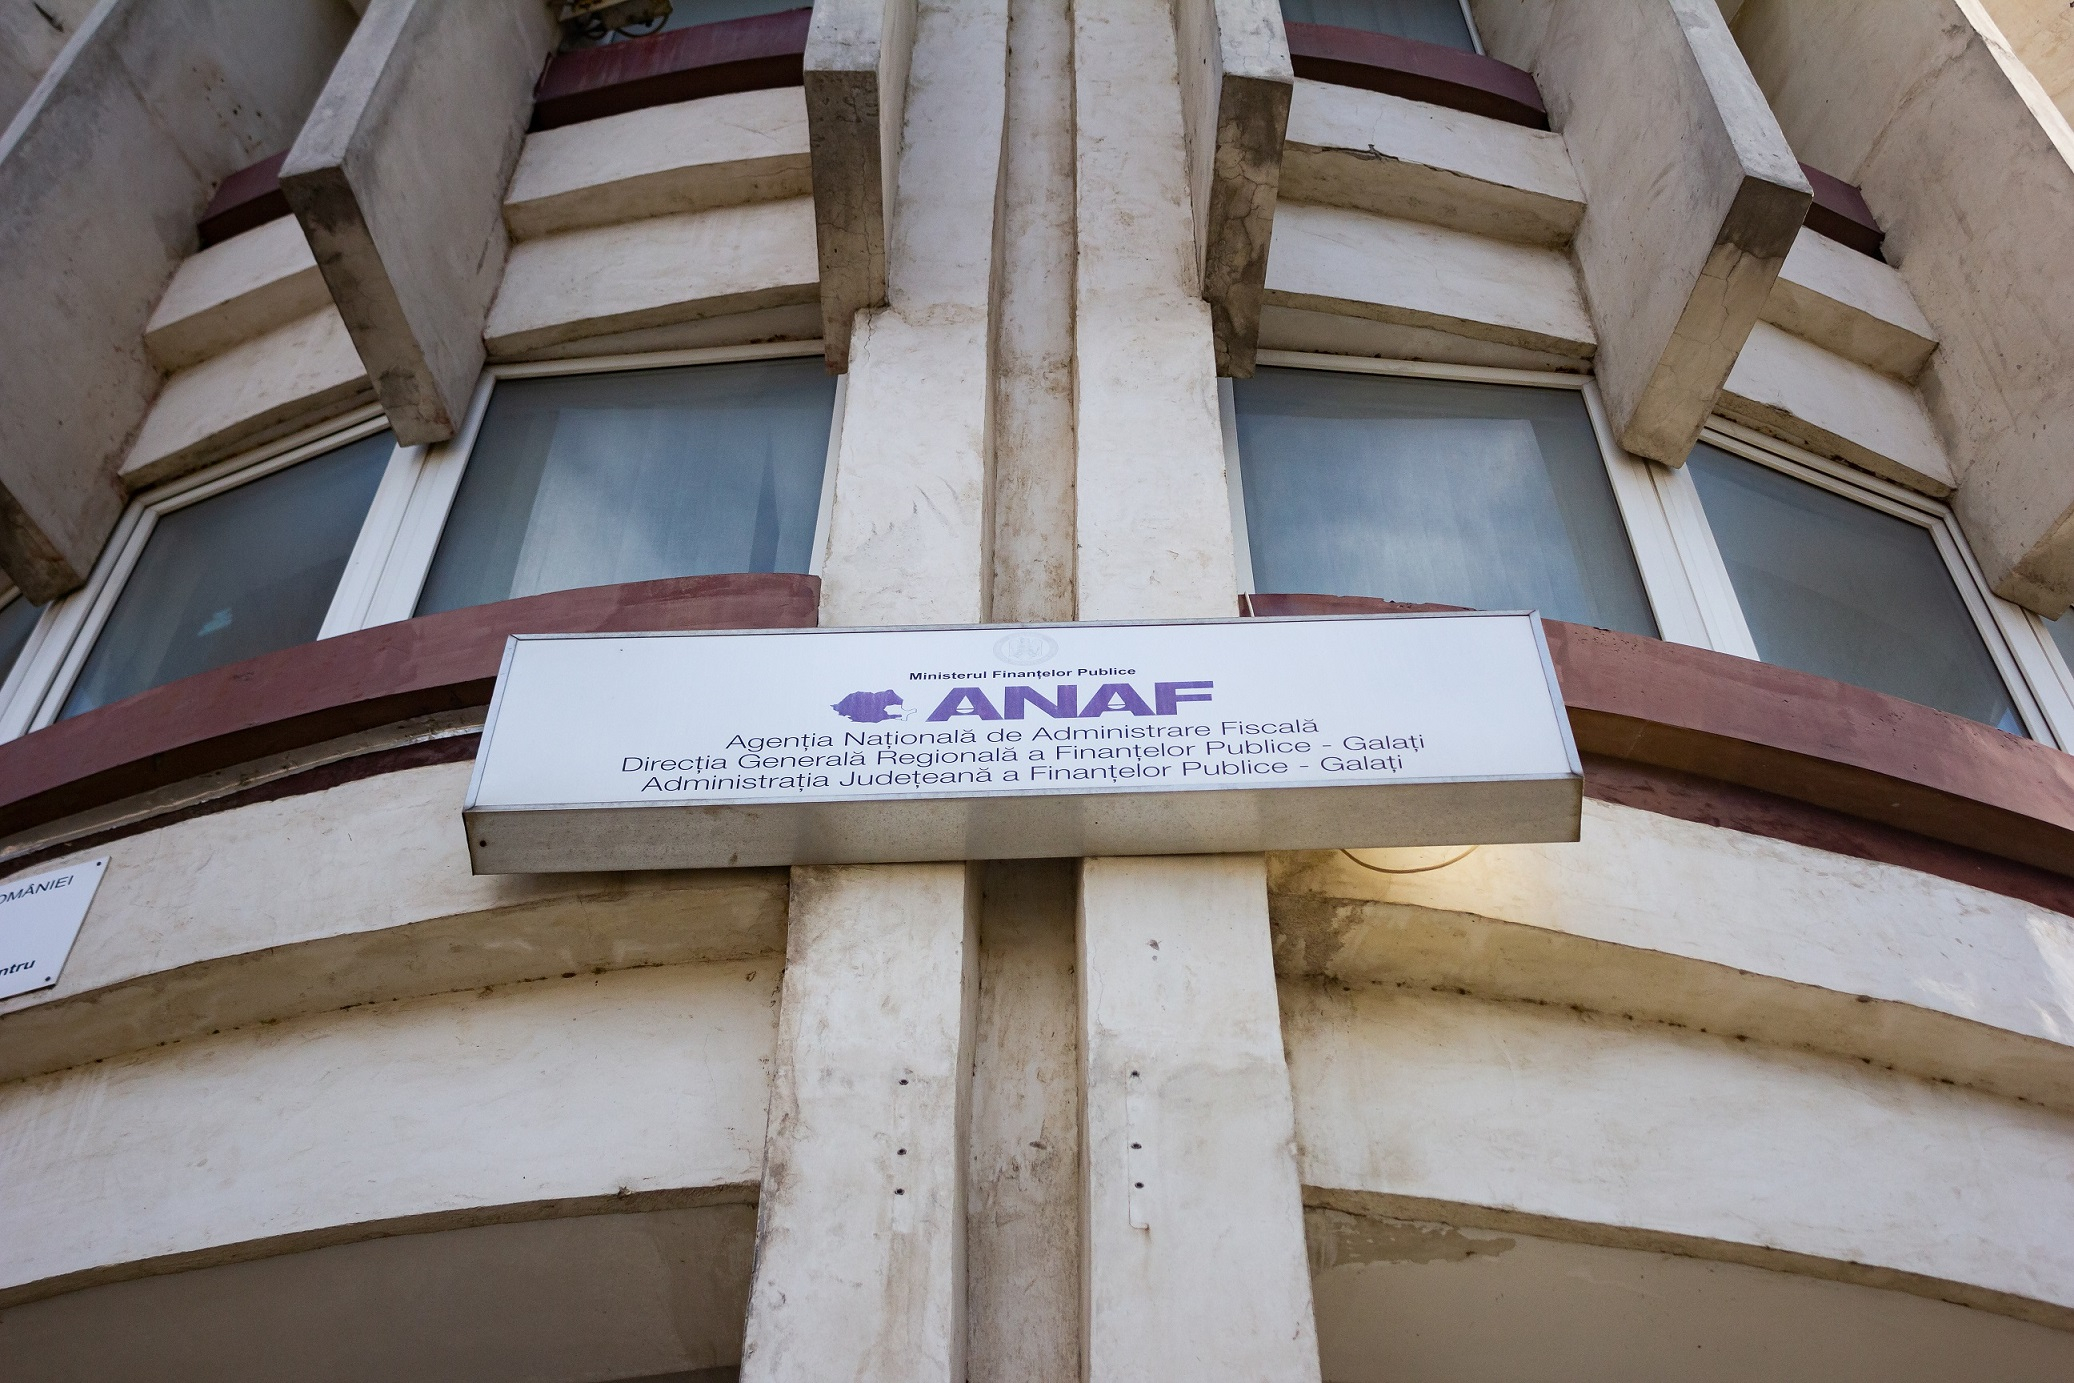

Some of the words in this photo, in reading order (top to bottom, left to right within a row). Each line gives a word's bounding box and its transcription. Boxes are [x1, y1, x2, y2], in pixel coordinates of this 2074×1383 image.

[909, 671, 987, 681] Ministerul
[992, 670, 1073, 680] Finanțelor
[1077, 667, 1136, 677] Publice
[926, 680, 1214, 723] ANAF
[621, 754, 727, 775] Direcția
[738, 751, 866, 769] Generală
[877, 747, 1018, 768] Regională
[1028, 749, 1046, 761] a
[1056, 742, 1196, 762] Finanțelor
[1206, 739, 1311, 756] Publice
[1343, 735, 1425, 753] Galați
[725, 732, 834, 753] Agenția
[844, 728, 977, 750] Națională
[986, 728, 1022, 743] de
[1031, 724, 1211, 742] Administrare
[1221, 718, 1319, 736] Fiscală
[640, 772, 830, 793] Administrația
[839, 767, 993, 789] Județeană
[1002, 770, 1020, 782] a
[1031, 762, 1172, 784] Finanțelor
[1182, 759, 1288, 777] Publice
[1320, 754, 1403, 774] Galați
